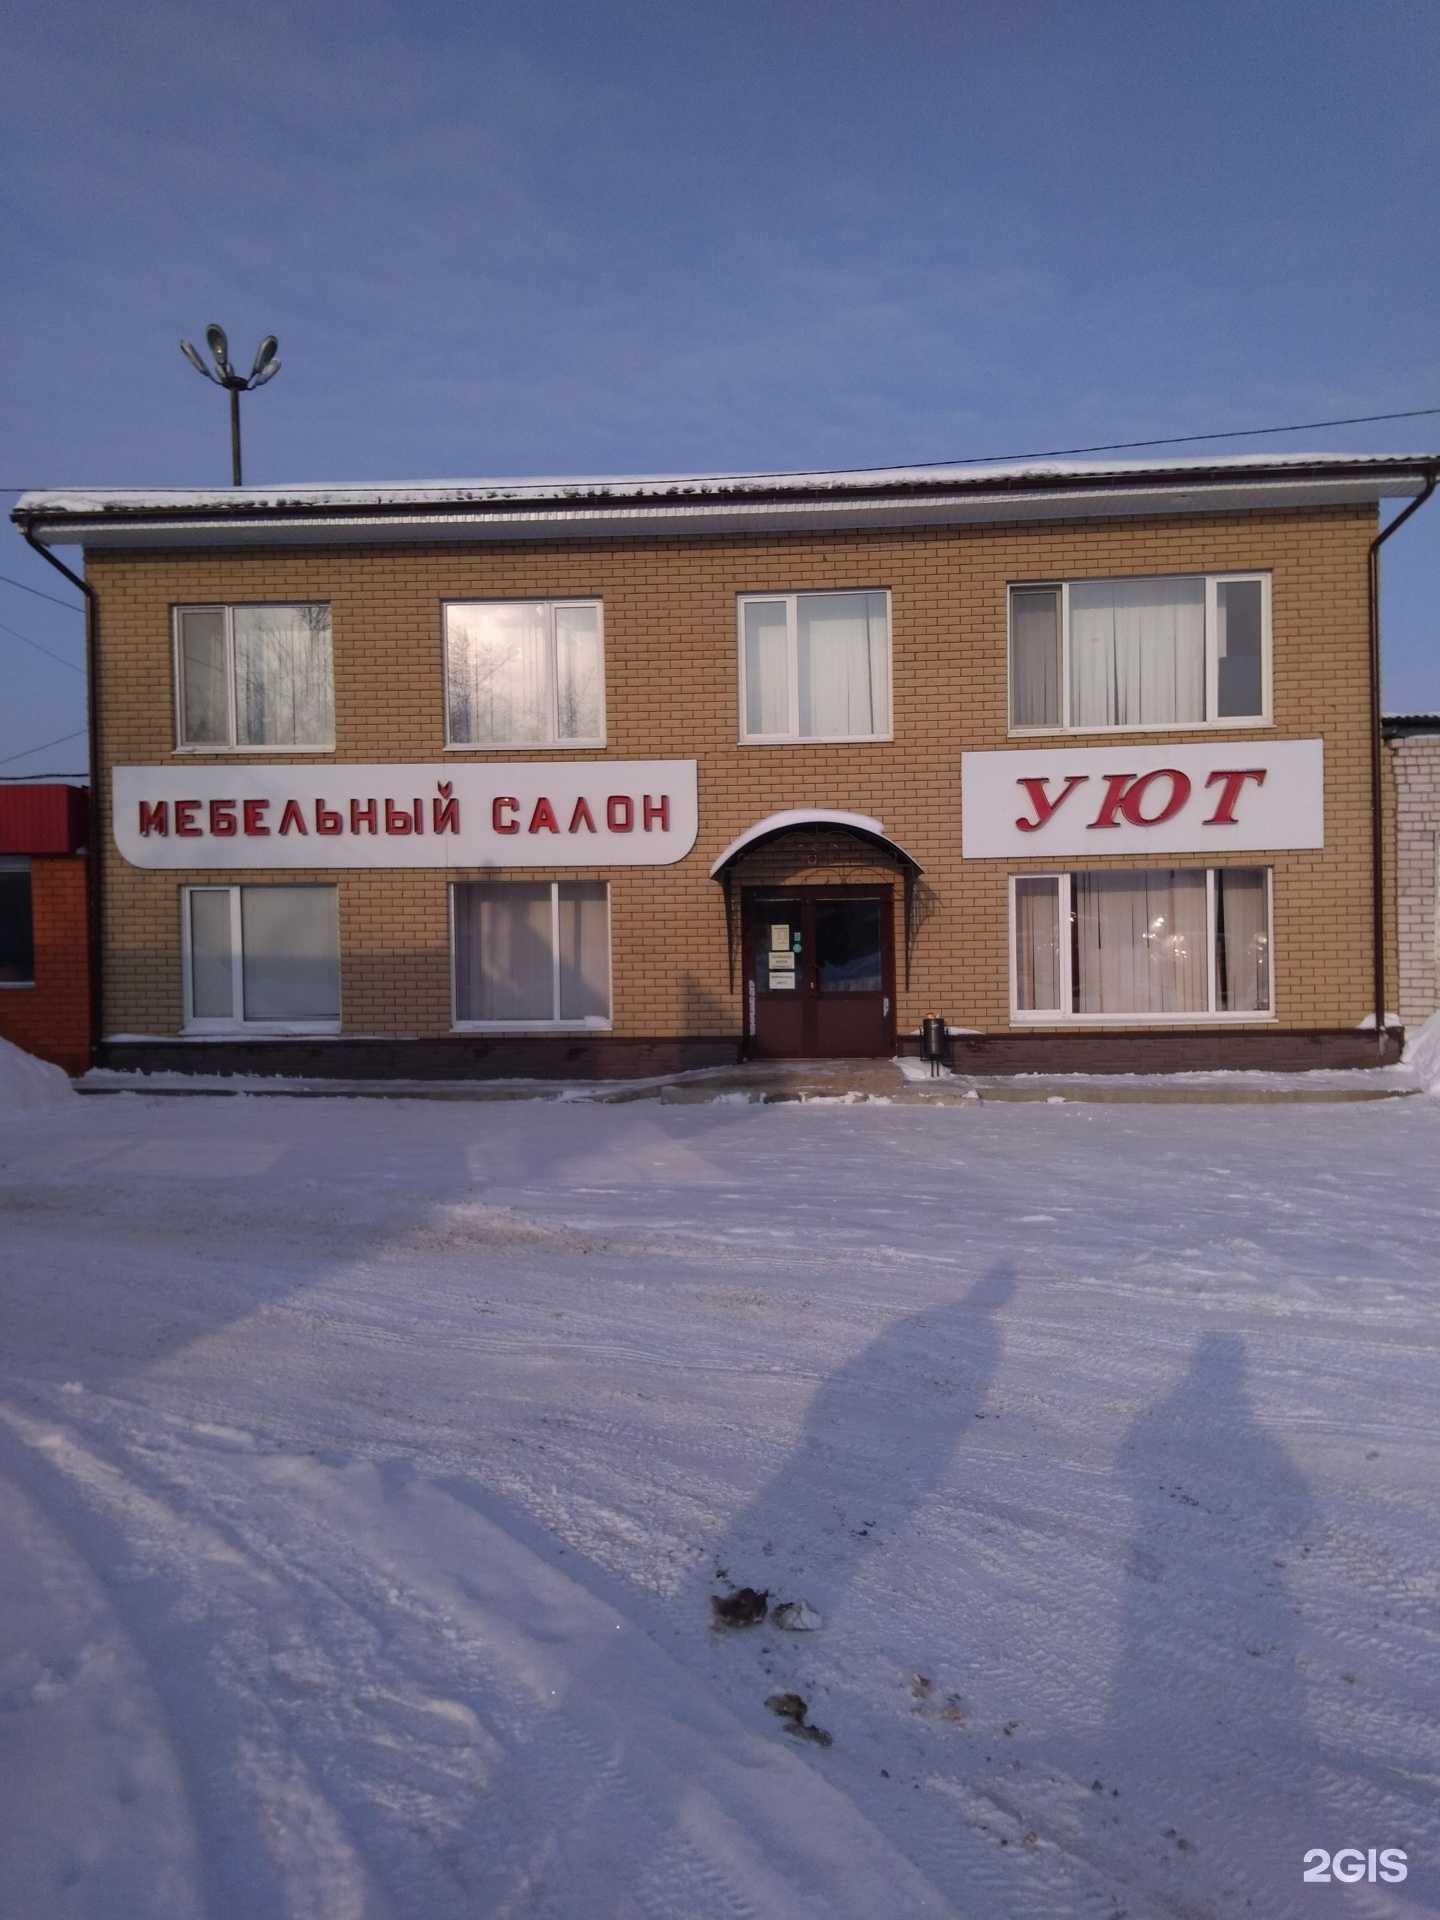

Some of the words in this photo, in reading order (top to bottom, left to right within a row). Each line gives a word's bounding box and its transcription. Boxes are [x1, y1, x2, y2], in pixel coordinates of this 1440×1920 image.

[138, 781, 461, 837] МЕБЕЛЬНЫЙ
[490, 794, 671, 834] САЛОН
[1015, 768, 1268, 832] УЮТ
